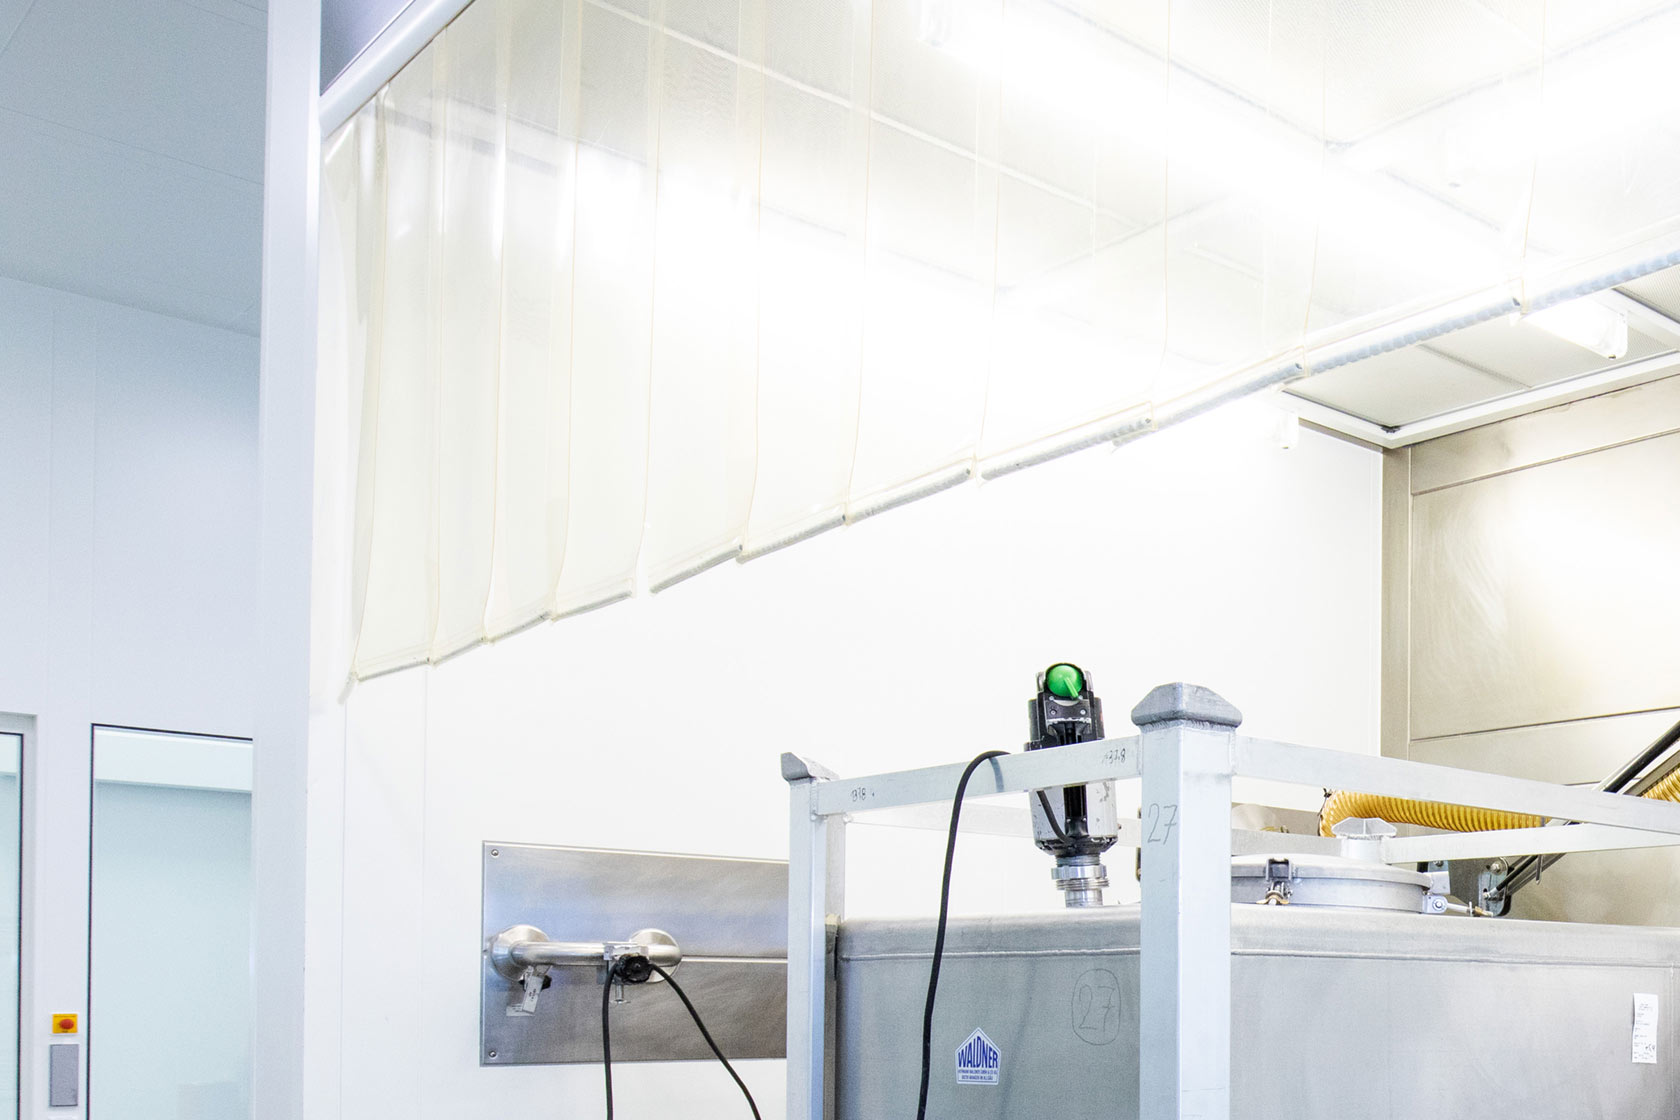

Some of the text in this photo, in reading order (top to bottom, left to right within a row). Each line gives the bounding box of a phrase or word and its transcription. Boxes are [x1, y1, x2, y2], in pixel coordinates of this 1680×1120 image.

[1147, 802, 1178, 846] 27
[1079, 984, 1115, 1032] 27
[958, 1036, 998, 1068] WALDNER
